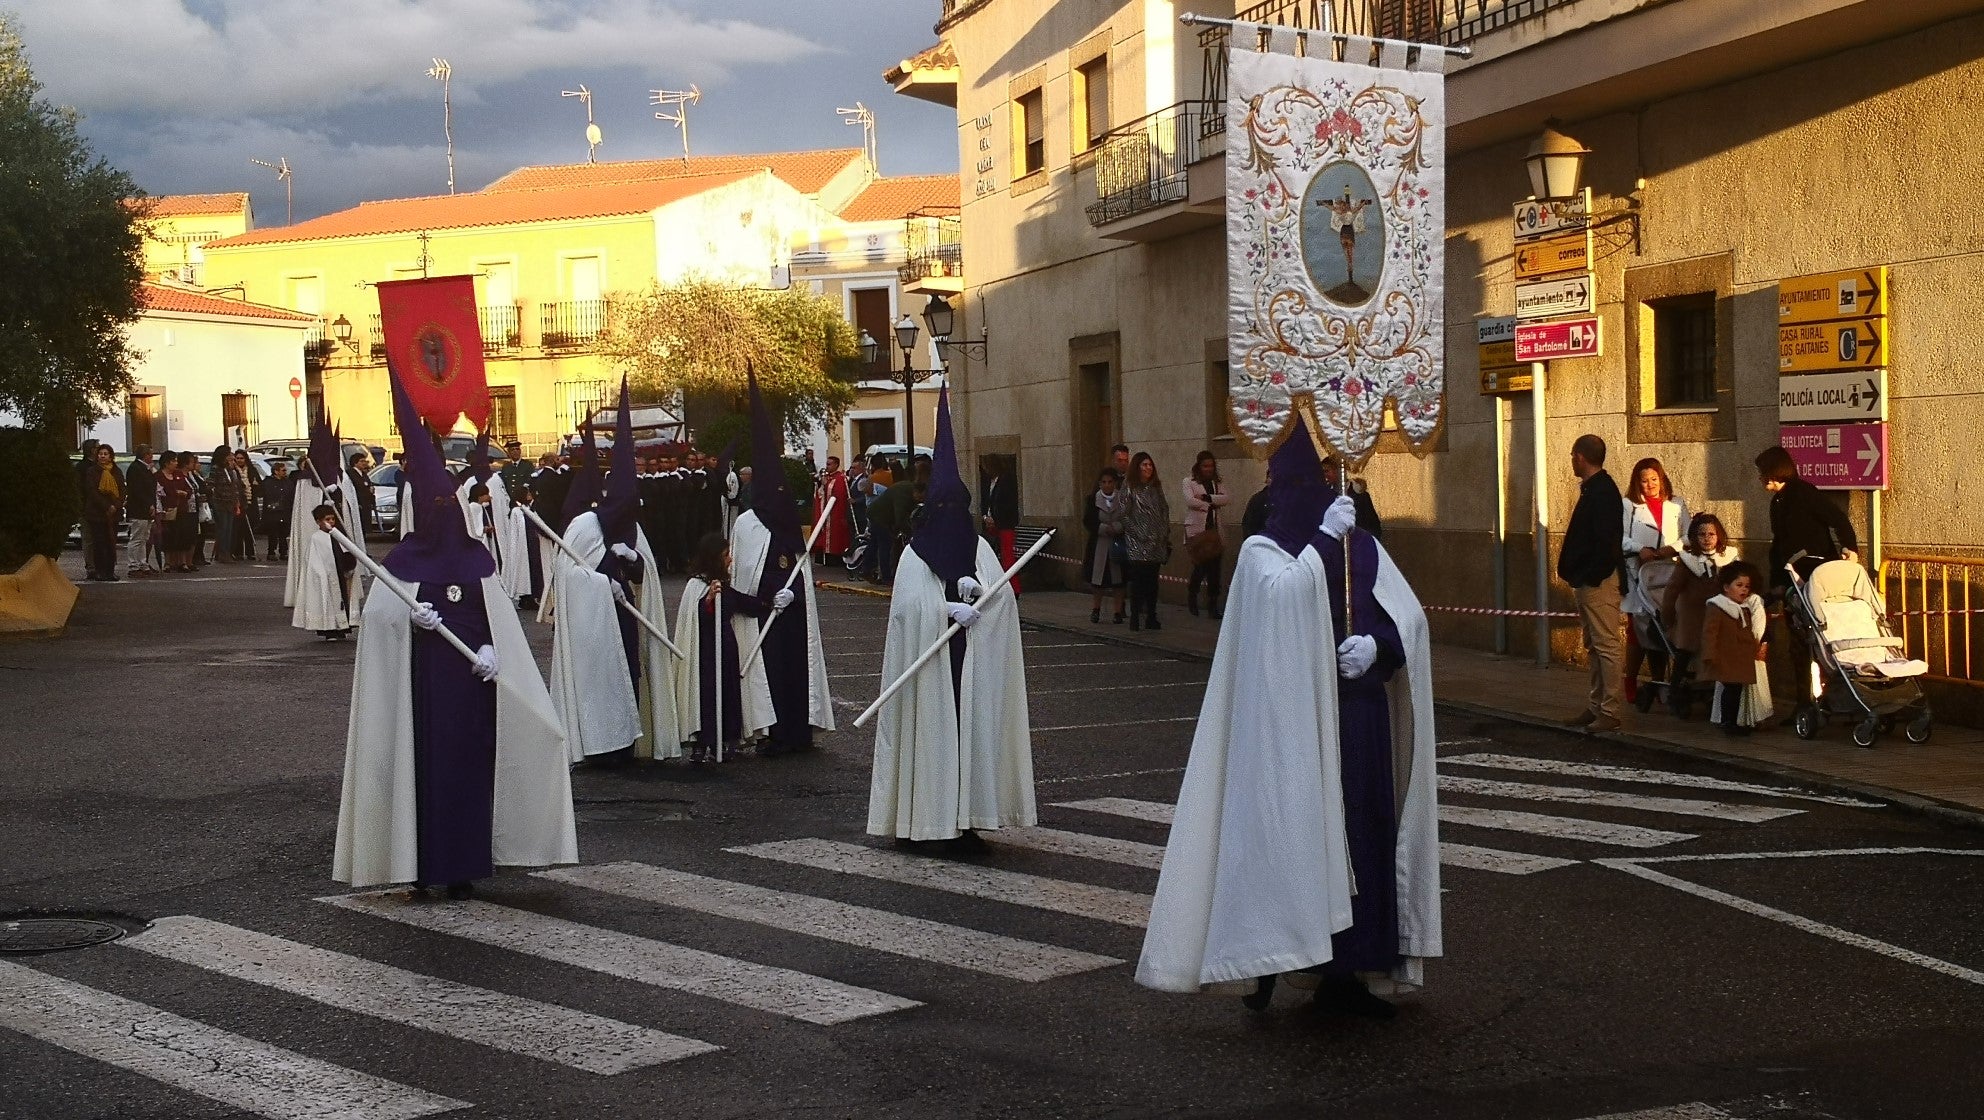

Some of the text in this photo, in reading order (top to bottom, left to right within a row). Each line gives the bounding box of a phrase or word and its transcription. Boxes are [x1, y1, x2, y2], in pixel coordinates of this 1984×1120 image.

[1558, 247, 1585, 261] correos
[1517, 291, 1563, 310] ayuntamiento
[1780, 288, 1831, 305] AYUNTAMIENTO
[1480, 322, 1504, 339] guardia
[1539, 331, 1546, 339] de
[1780, 327, 1824, 342] CASA RURAL
[1518, 343, 1531, 354] San
[1534, 340, 1568, 353] Bartolomé
[1780, 341, 1829, 357] LOS GAITANES
[1780, 388, 1847, 407] POLICÍA LOCAL
[1781, 435, 1823, 448] BIBLIOTECA
[1802, 463, 1813, 476] DE
[1814, 463, 1849, 476] CULTURA
